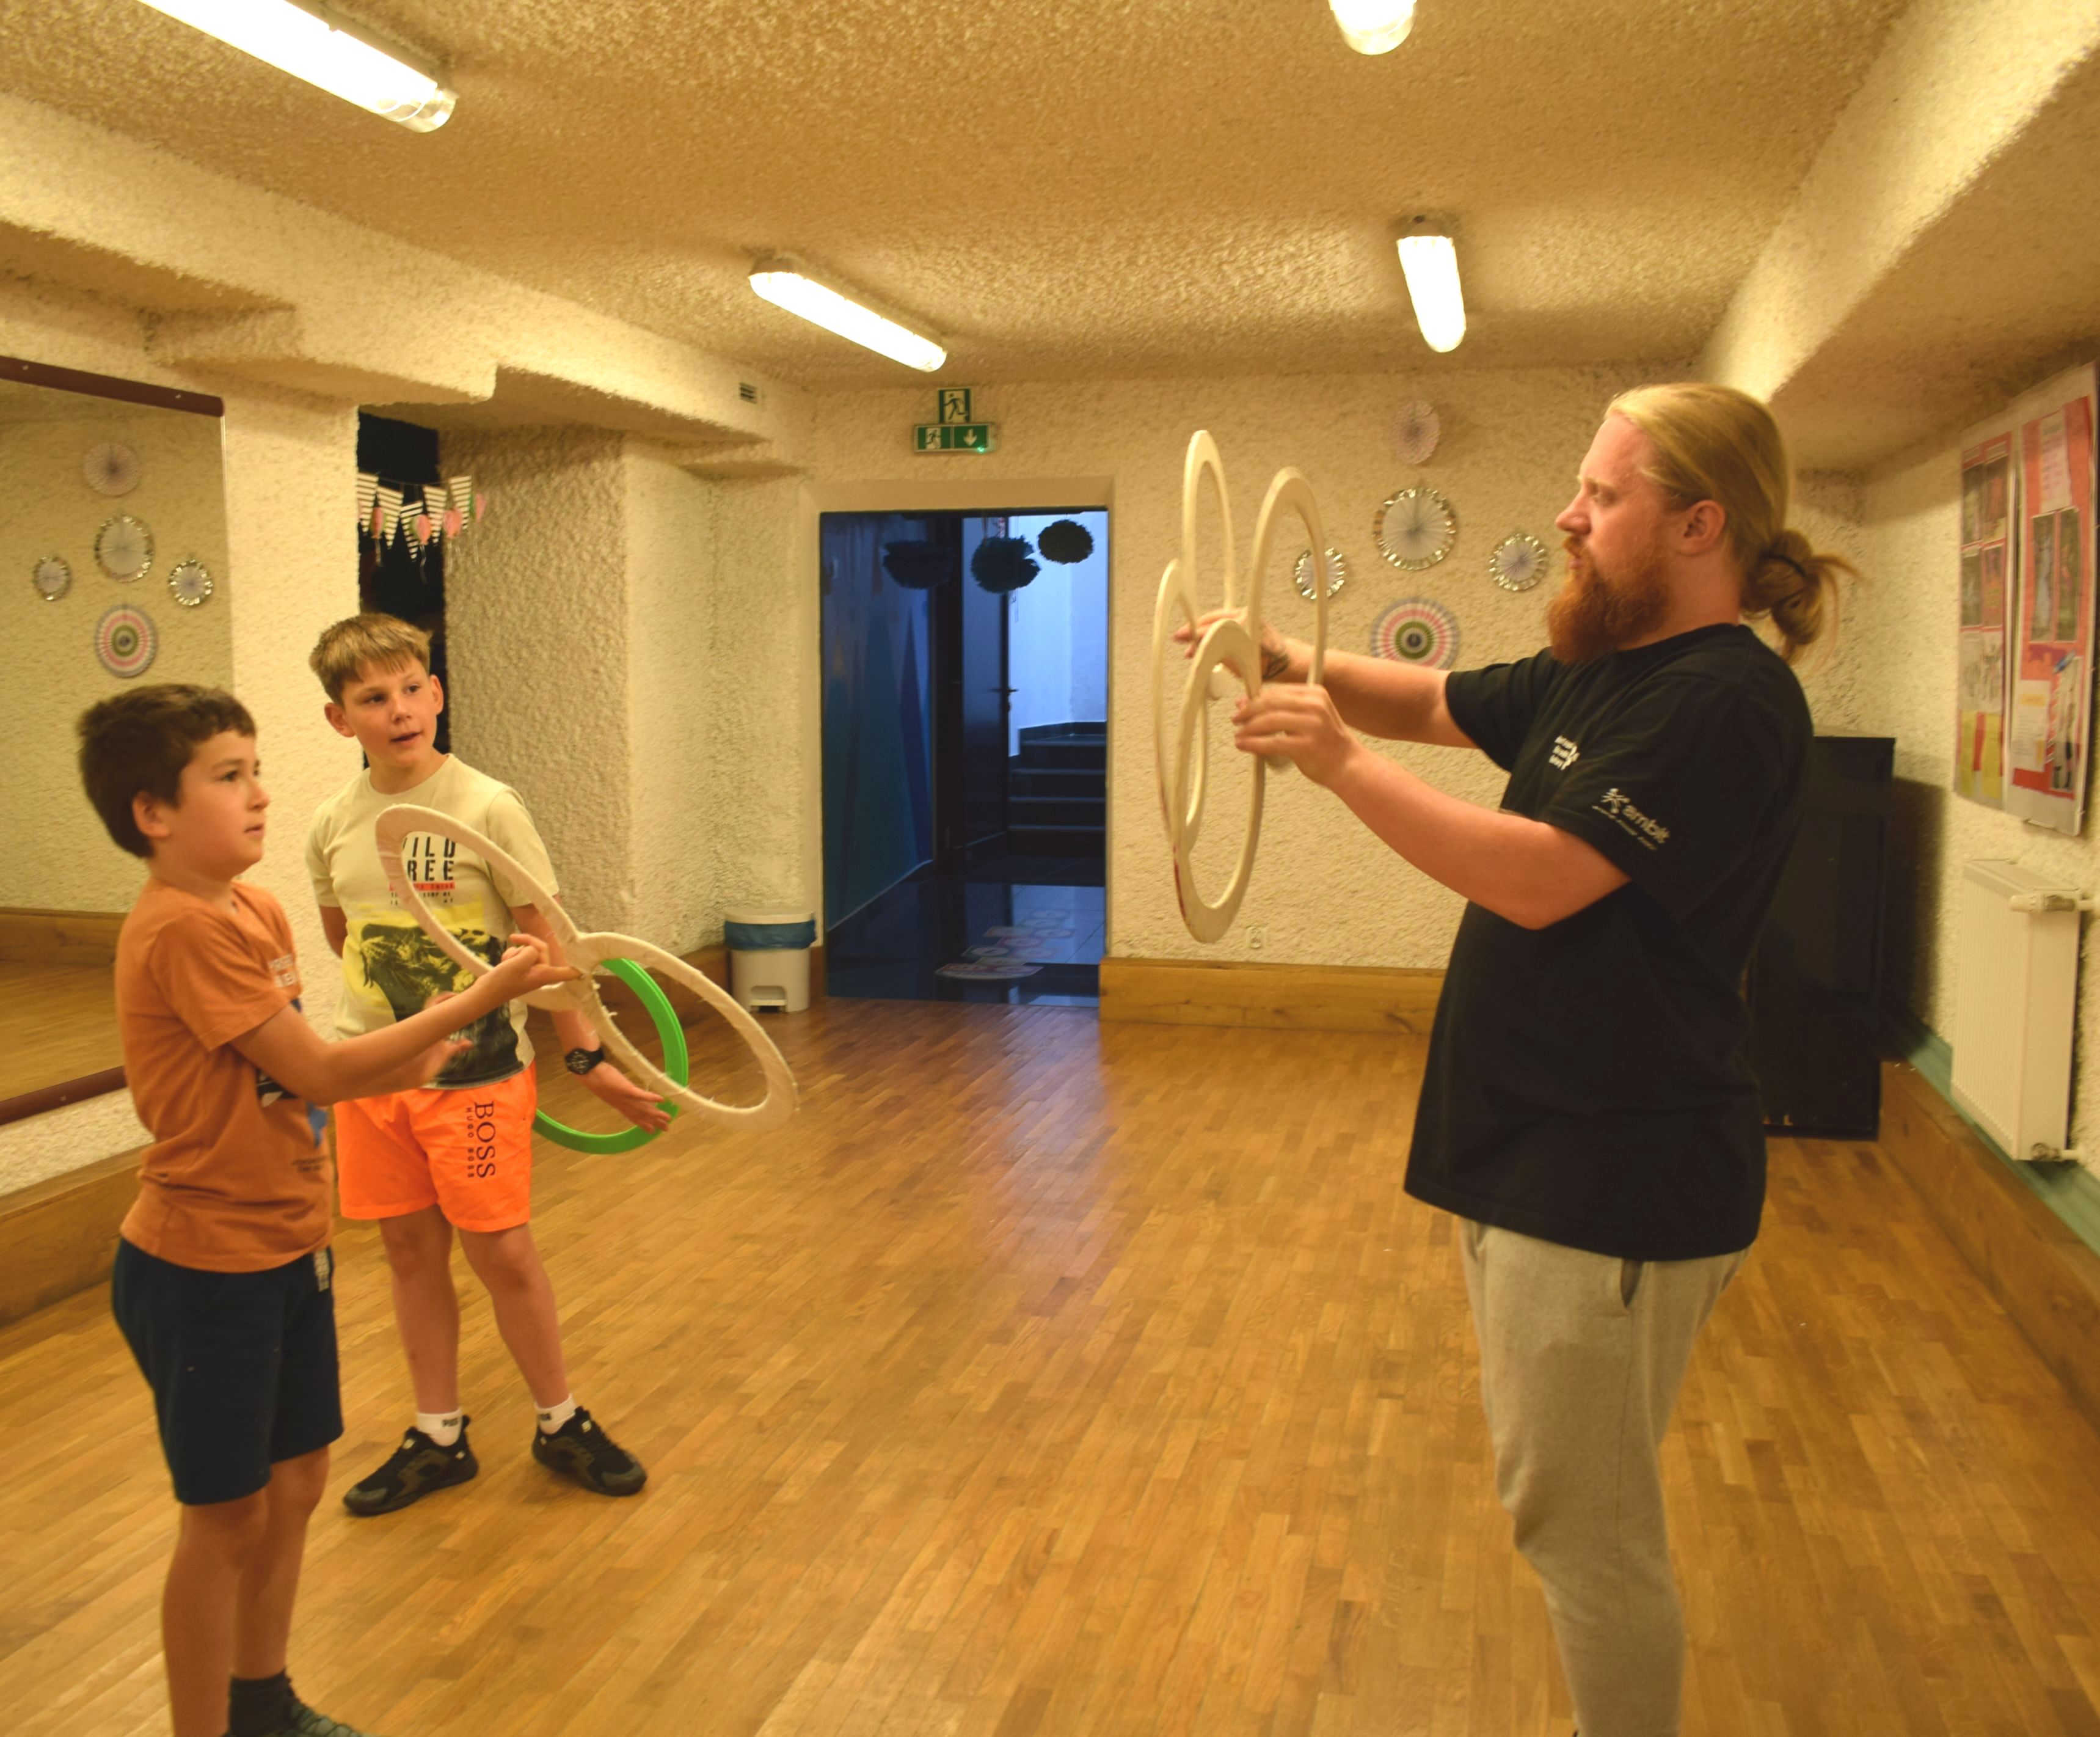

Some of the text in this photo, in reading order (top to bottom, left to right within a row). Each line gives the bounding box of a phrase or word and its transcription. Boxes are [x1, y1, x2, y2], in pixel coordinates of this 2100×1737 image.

[403, 836, 456, 858] ILD
[407, 860, 454, 881] REE
[475, 1101, 495, 1178] BOSS
